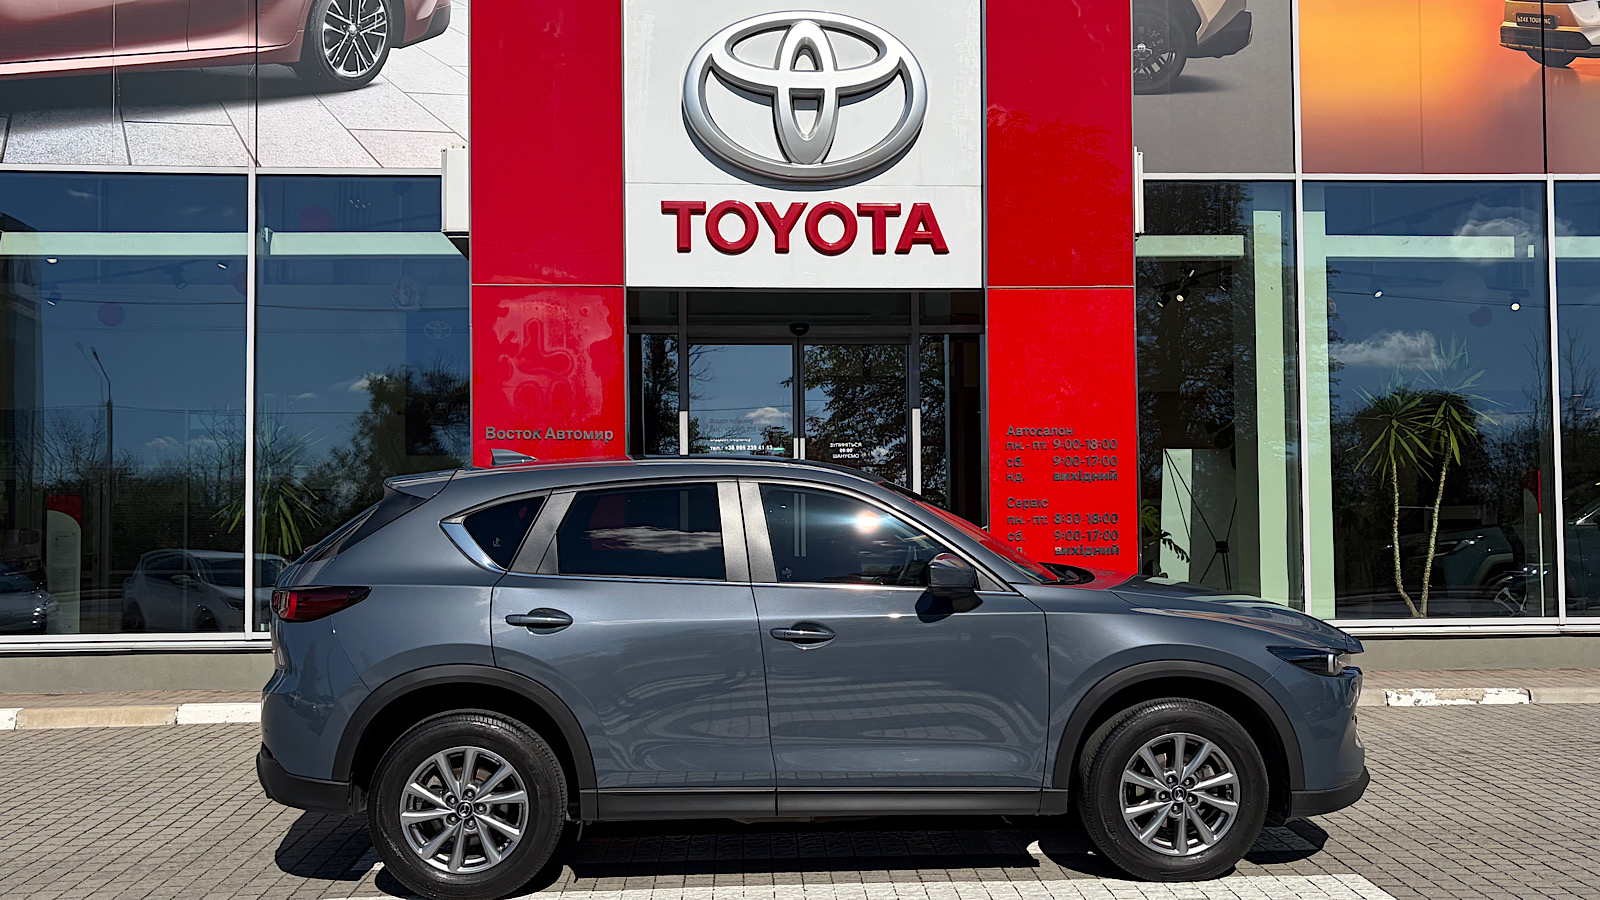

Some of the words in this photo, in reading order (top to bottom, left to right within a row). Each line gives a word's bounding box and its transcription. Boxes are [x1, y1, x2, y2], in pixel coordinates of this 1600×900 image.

[1529, 17, 1551, 25] TOURNG
[661, 200, 950, 256] TOYOTA
[485, 426, 541, 440] Восток
[545, 427, 614, 444] Автомир
[1006, 425, 1074, 436] Автосалон
[1053, 439, 1118, 450] 9:00-18:00
[1006, 456, 1025, 467] сб.
[1053, 456, 1118, 467] 9:00-17:00
[1006, 472, 1026, 483] нд.
[1053, 469, 1118, 483] вихідний
[1006, 497, 1049, 510] Сервіс
[1054, 513, 1119, 524] 8:30-18:00
[1007, 530, 1026, 542] сб.
[1054, 530, 1119, 541] 9:00-17:00
[1054, 544, 1120, 557] вихідний
